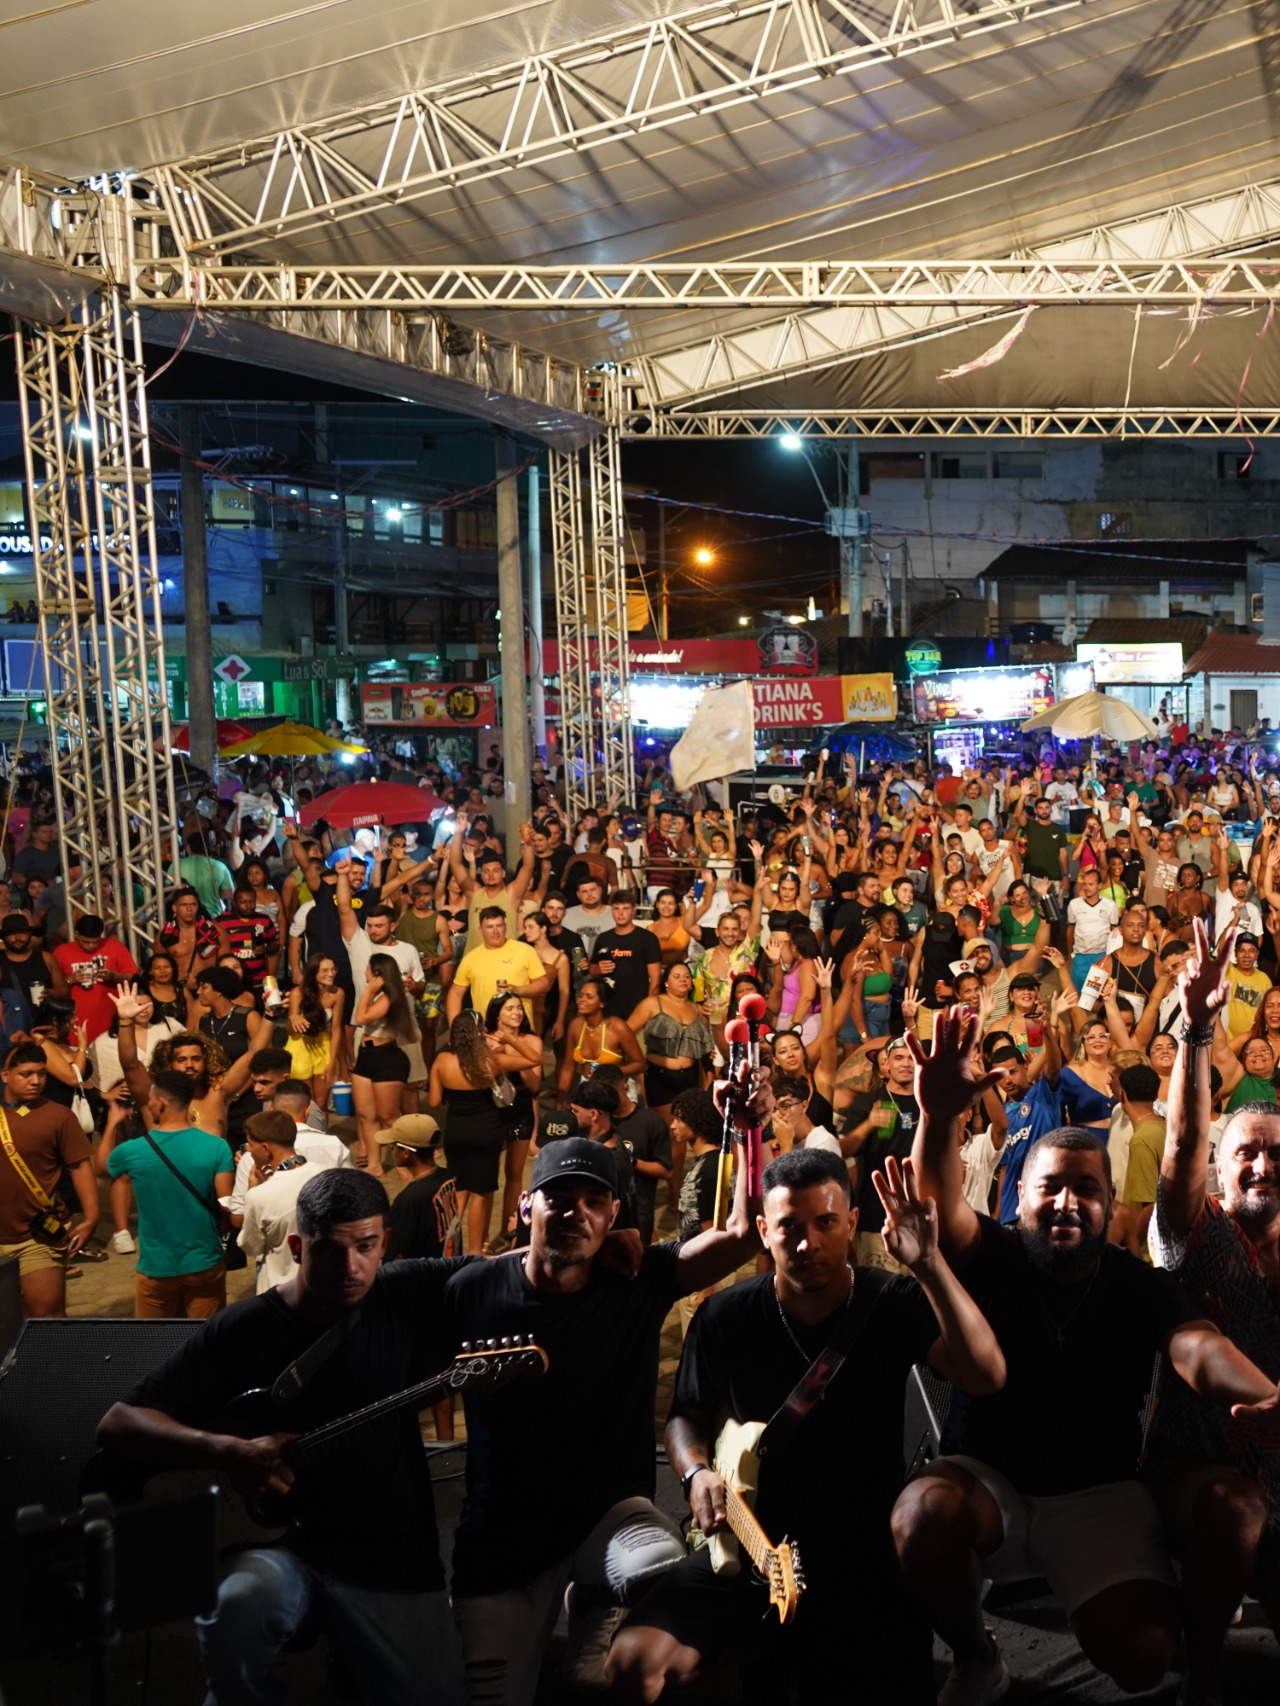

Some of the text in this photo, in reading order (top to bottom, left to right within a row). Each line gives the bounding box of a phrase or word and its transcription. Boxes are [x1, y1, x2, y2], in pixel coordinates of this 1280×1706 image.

[905, 651, 942, 662] TOP BAR
[284, 664, 302, 680] Lua
[303, 669, 309, 679] &
[311, 662, 328, 679] Sol
[922, 679, 950, 697] Vixe
[353, 814, 378, 826] ITAIPAVA
